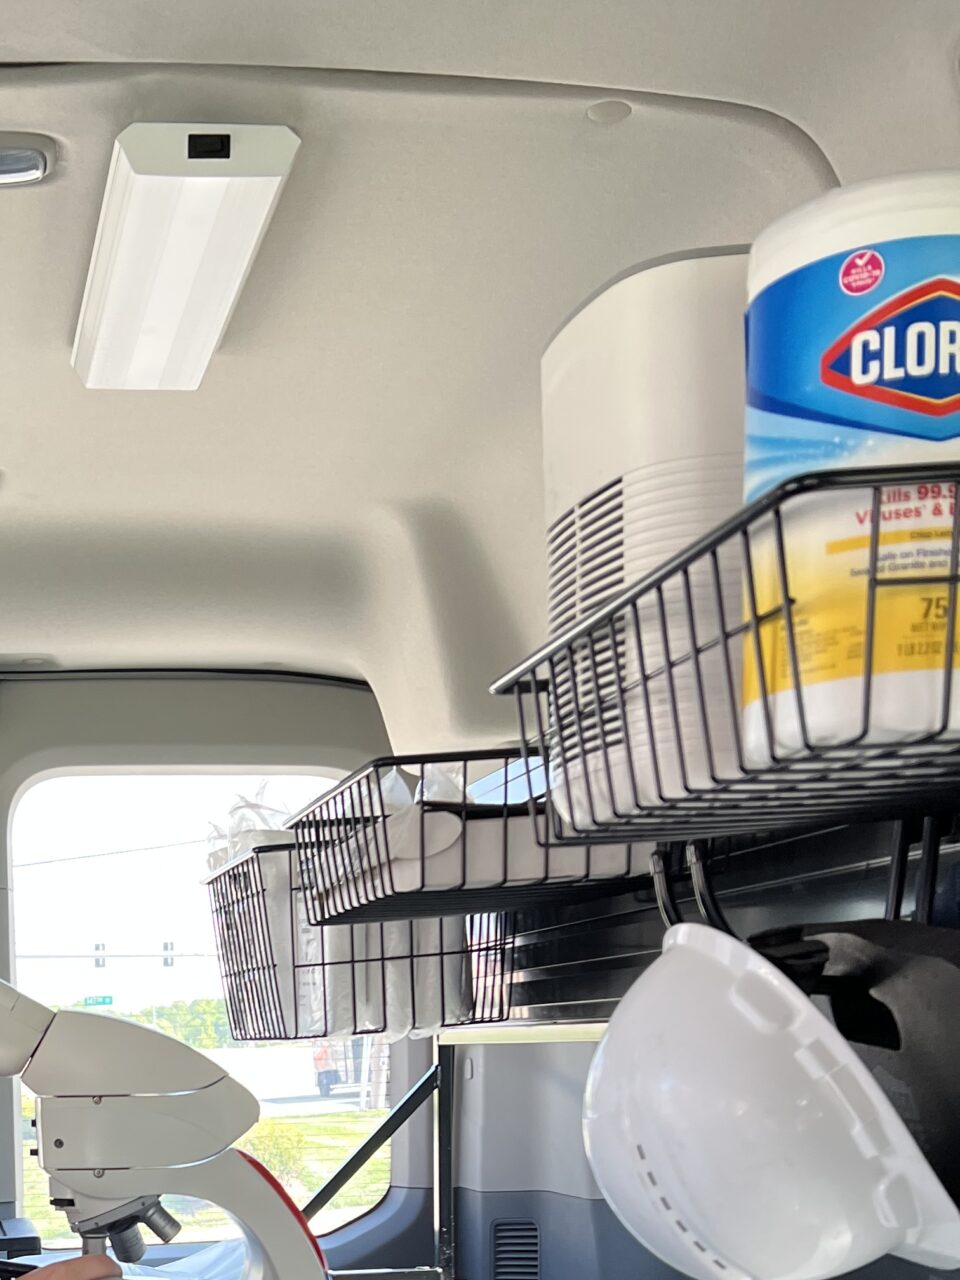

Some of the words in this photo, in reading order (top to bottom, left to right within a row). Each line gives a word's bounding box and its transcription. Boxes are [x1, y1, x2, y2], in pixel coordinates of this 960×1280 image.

[850, 321, 960, 386] CLOR
[881, 488, 911, 503] ills
[932, 502, 943, 516] &
[920, 597, 948, 619] 75
